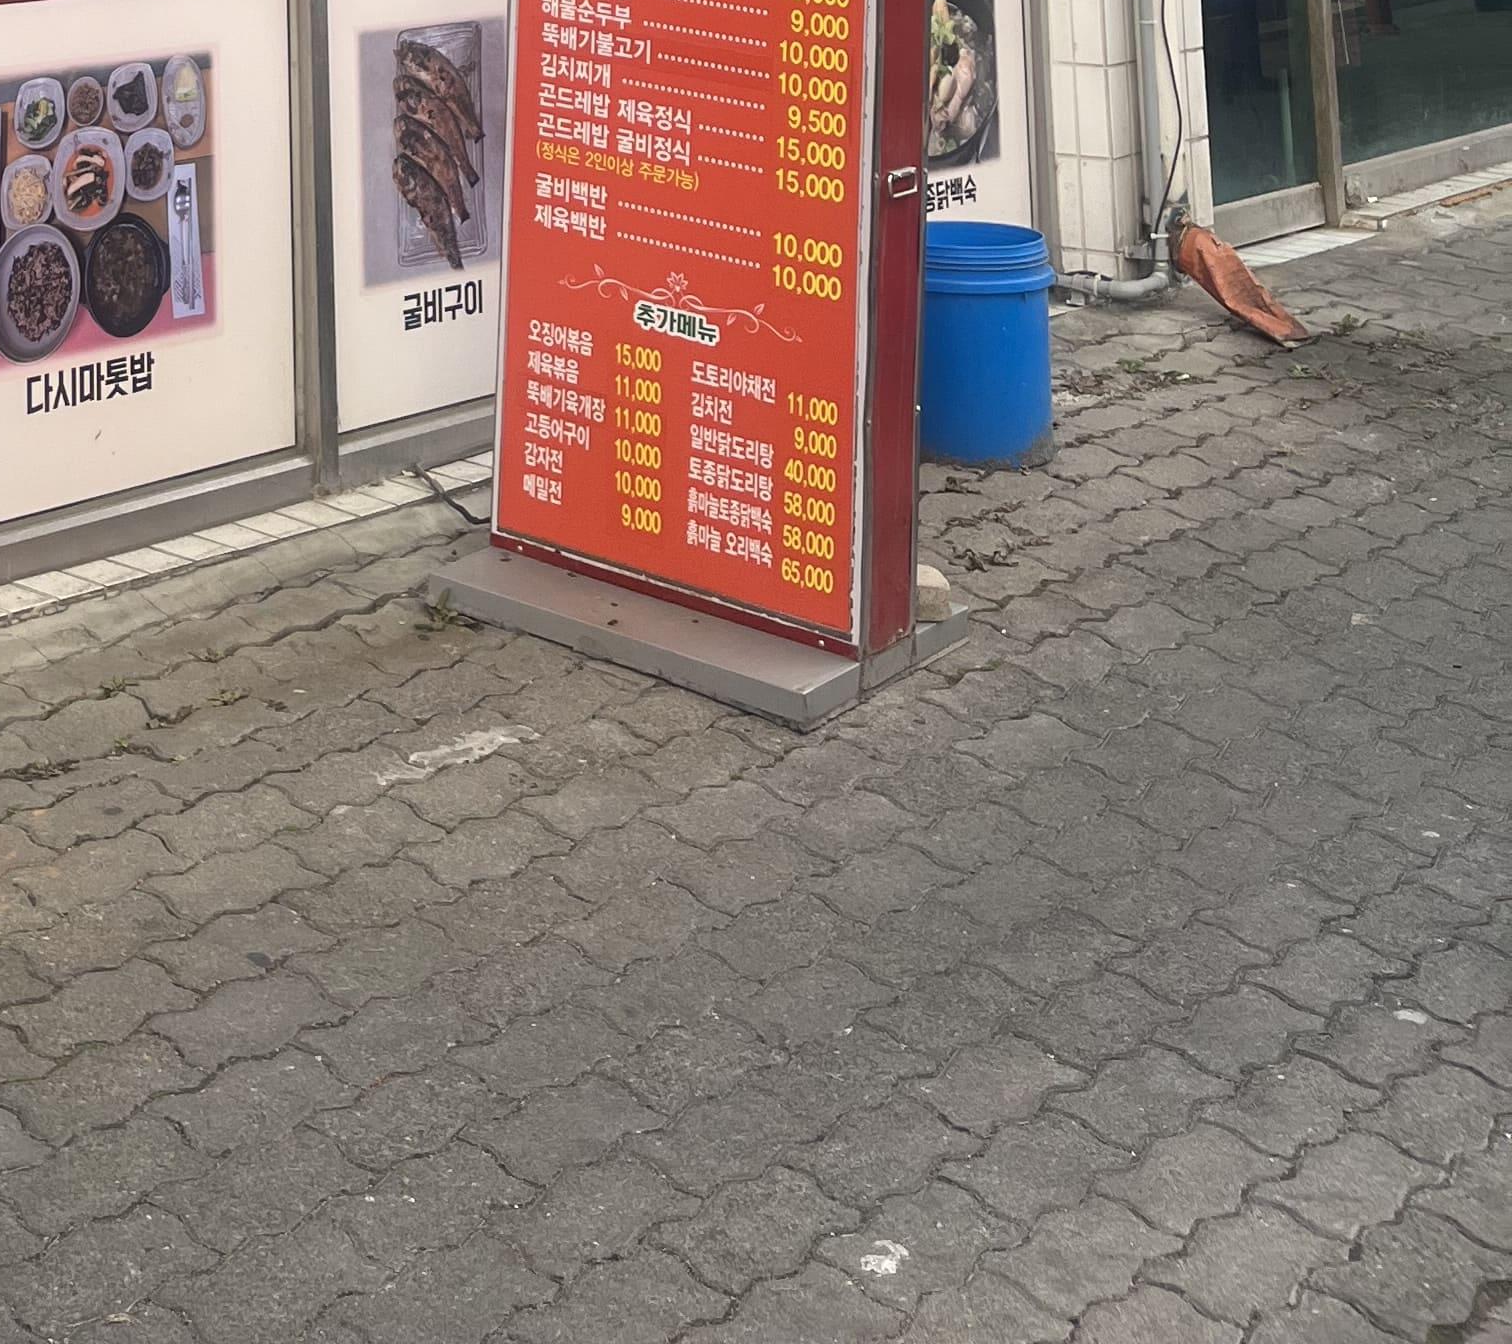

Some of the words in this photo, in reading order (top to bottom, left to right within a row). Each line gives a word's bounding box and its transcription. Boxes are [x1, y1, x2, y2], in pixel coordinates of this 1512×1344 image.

[779, 39, 849, 73] 10,000
[790, 9, 849, 41] 9,000
[539, 52, 611, 88] 김치찌개
[787, 104, 847, 138] 9,500
[541, 22, 651, 64] 뚝배기불고기
[778, 71, 848, 105] 10,000
[537, 112, 609, 149] 곤드레밥
[616, 127, 691, 166] 굴비정식
[775, 167, 845, 203] 15,000
[538, 82, 610, 118] 곤드레밥
[617, 98, 692, 135] 제육정식
[776, 135, 846, 170] 15,000
[535, 139, 580, 166] (정식은
[585, 150, 634, 178] 2인이상
[639, 161, 699, 192] 주문가능)
[533, 202, 607, 241] 제육백반
[772, 264, 842, 301] 10,000
[535, 171, 608, 210] 굴비백반
[773, 231, 843, 269] 10,000
[403, 279, 483, 331] 굴비구이
[635, 301, 719, 346] 추가메뉴
[527, 318, 593, 357] 오징어볶음
[615, 342, 662, 373] 15,000
[25, 351, 157, 415] 다시마톳밥
[526, 379, 606, 424] 뚝배기육개장
[614, 406, 662, 437] 11,000
[527, 350, 579, 385] 제육볶음
[615, 374, 662, 405] 11,000
[691, 360, 777, 405] 도토리야채전
[787, 391, 838, 426] 11,000
[524, 411, 590, 450] 고등어구이
[614, 438, 662, 470] 10,000
[690, 392, 733, 426] 김치전
[793, 426, 837, 459] 9,000
[523, 442, 563, 475] 감자전
[614, 470, 662, 503] 10,000
[689, 423, 775, 470] 일반닭도리탕
[784, 458, 836, 493] 40,000
[522, 472, 563, 505] 메밀전
[621, 503, 662, 535] 9,000
[688, 456, 774, 502] 토종닭도리탕
[783, 491, 836, 526] 58,000
[724, 531, 774, 568] 오리백숙
[781, 558, 834, 594] 65,000
[782, 525, 835, 560] 58,000
